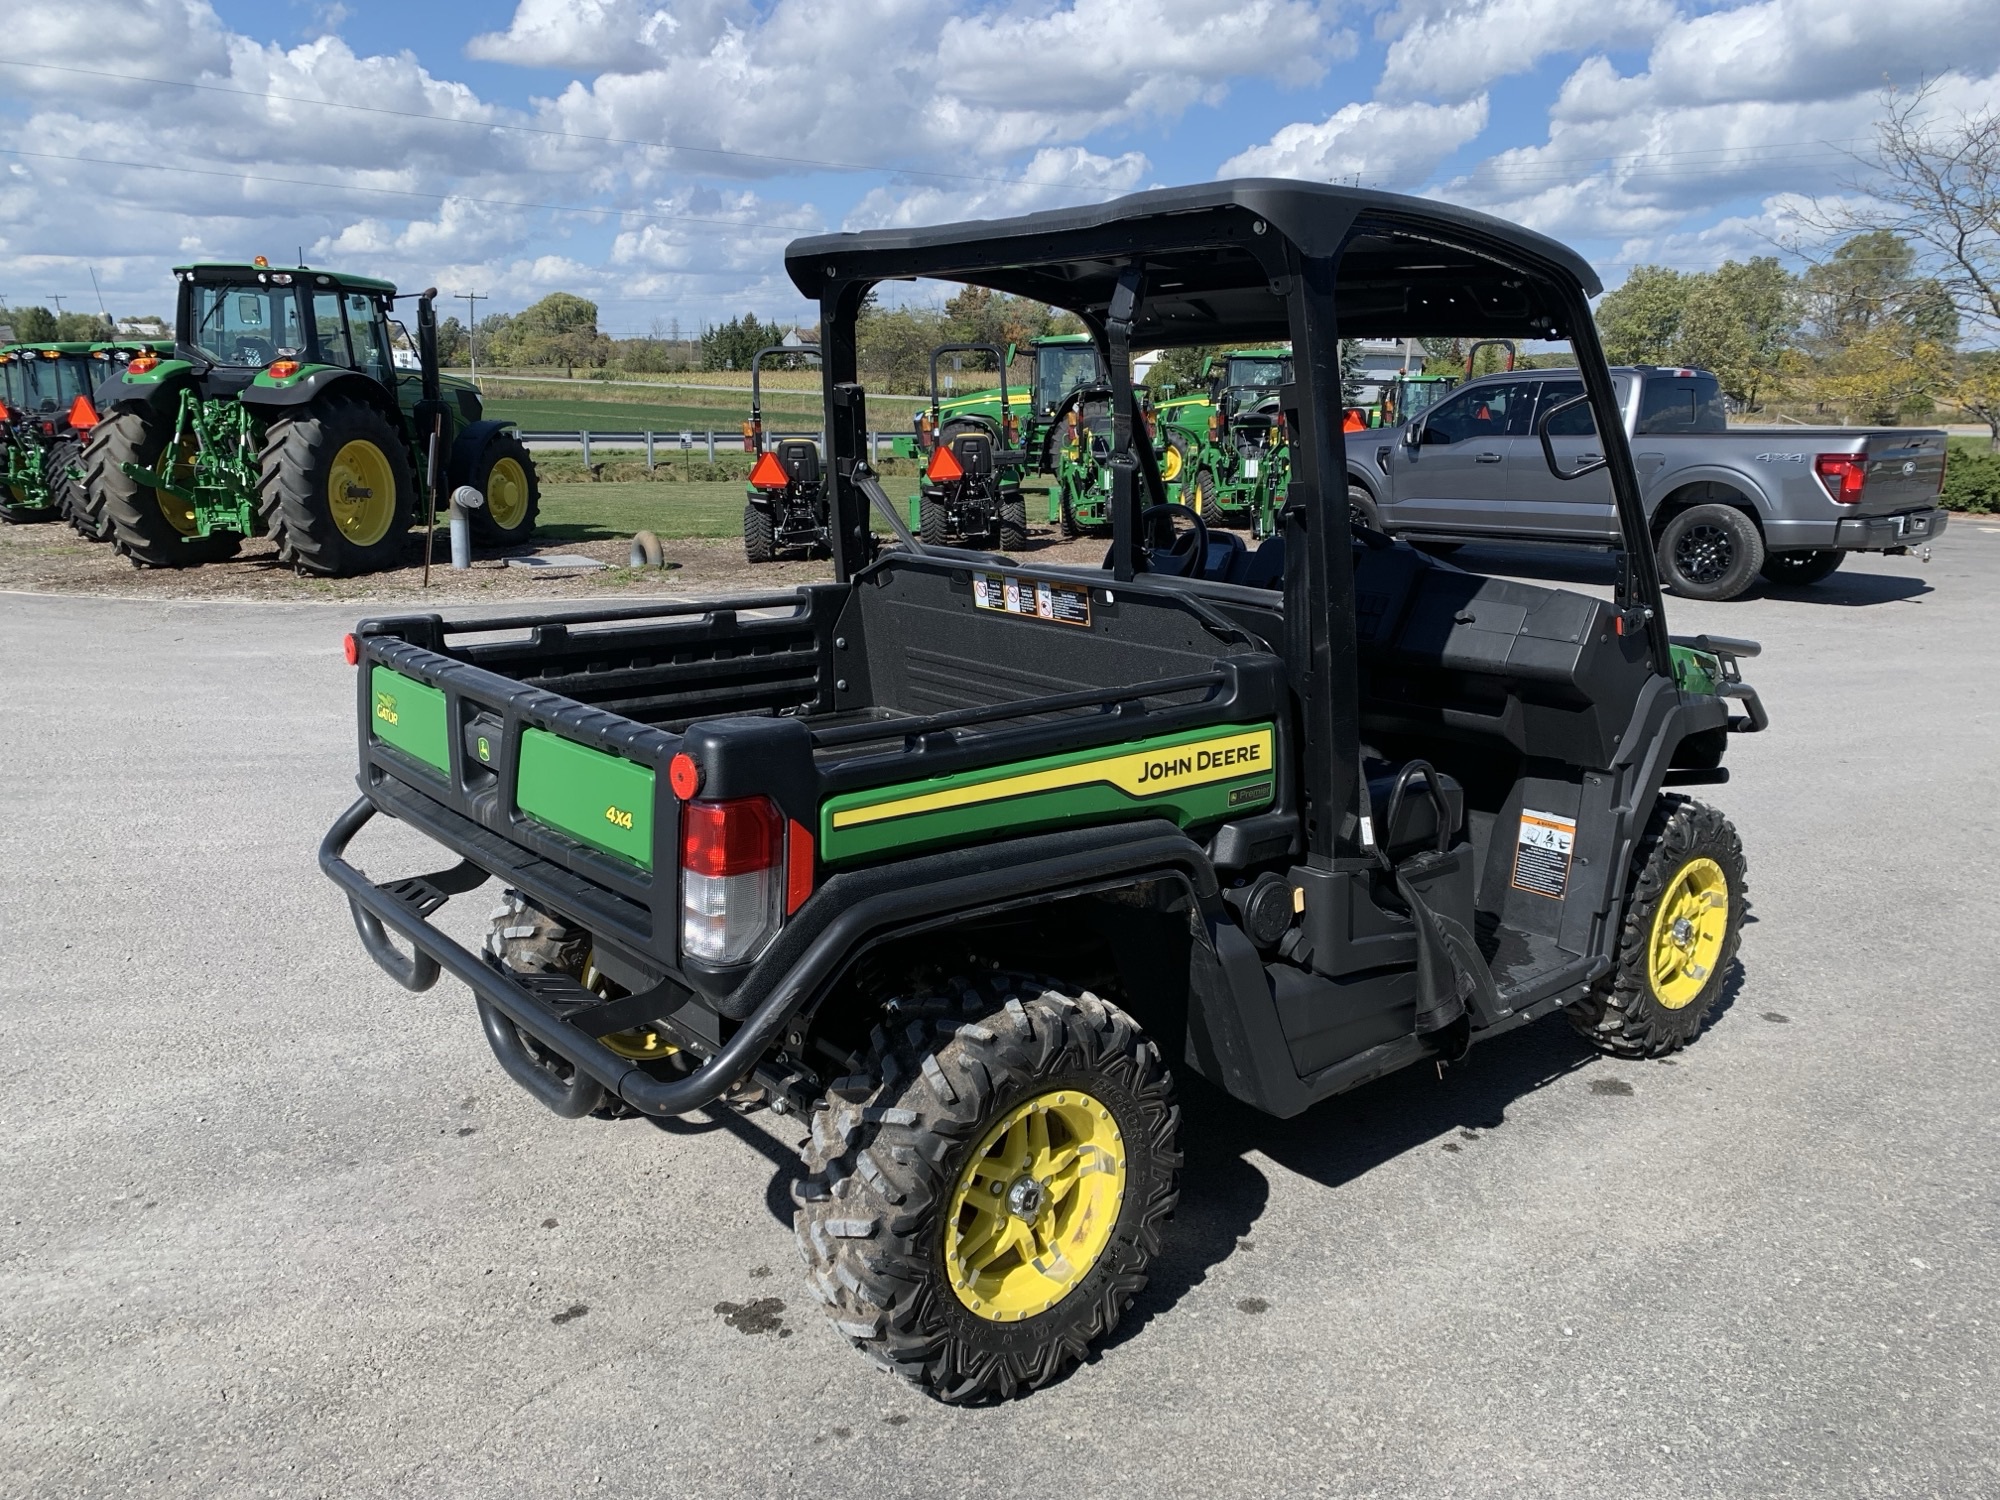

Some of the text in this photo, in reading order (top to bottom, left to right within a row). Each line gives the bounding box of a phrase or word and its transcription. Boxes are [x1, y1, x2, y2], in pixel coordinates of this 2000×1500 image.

[377, 703, 398, 726] GATOR
[1138, 744, 1260, 783] JOHN DEERE
[1240, 786, 1270, 800] Premier
